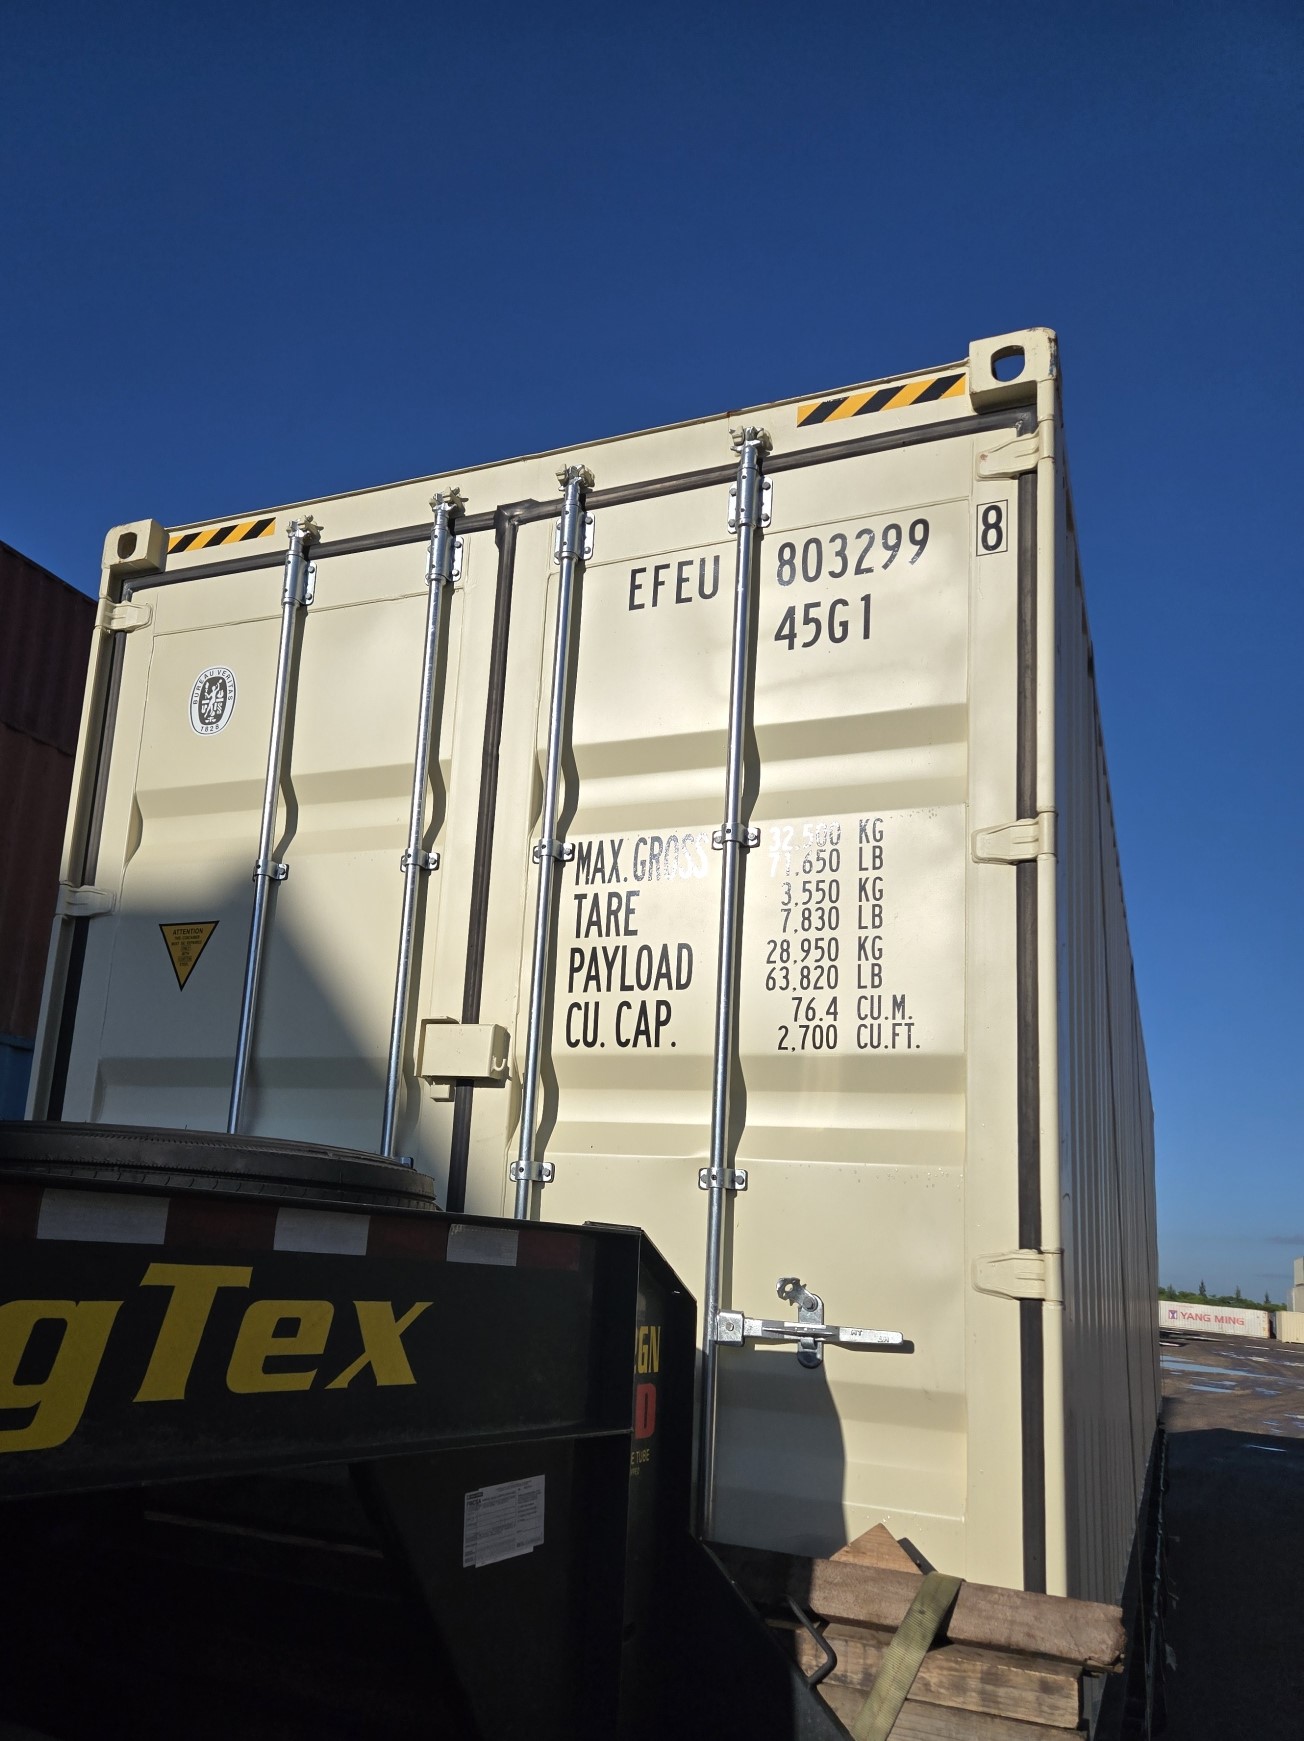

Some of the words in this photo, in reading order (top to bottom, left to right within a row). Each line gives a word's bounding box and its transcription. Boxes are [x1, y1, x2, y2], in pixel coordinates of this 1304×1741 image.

[628, 555, 720, 611] EFEU
[776, 517, 930, 587] 803299
[980, 503, 1003, 553] 8
[774, 593, 872, 651] 45G1
[193, 670, 214, 705] BUREAU
[217, 669, 234, 701] VERITAS
[858, 817, 884, 844] KG
[858, 844, 884, 872] LB
[780, 878, 841, 907] 3,550
[858, 876, 884, 903] KG
[573, 889, 641, 939] TARE
[780, 907, 840, 934] 7,830
[857, 903, 884, 930] LB
[172, 927, 204, 936] ATTENTION
[567, 942, 694, 993] PAYLOAD
[766, 936, 840, 965] 28,950
[857, 935, 883, 962] KG
[765, 964, 839, 993] 63,820
[857, 962, 883, 990] LB
[565, 1000, 606, 1048] CU.
[615, 999, 677, 1048] CAP.
[791, 995, 839, 1023] 76.4
[856, 993, 913, 1021] CU.M.
[777, 1023, 838, 1052] 2,700
[856, 1022, 921, 1050] CU.FT.
[1179, 1311, 1211, 1323] YANG
[1214, 1314, 1245, 1326] MING
